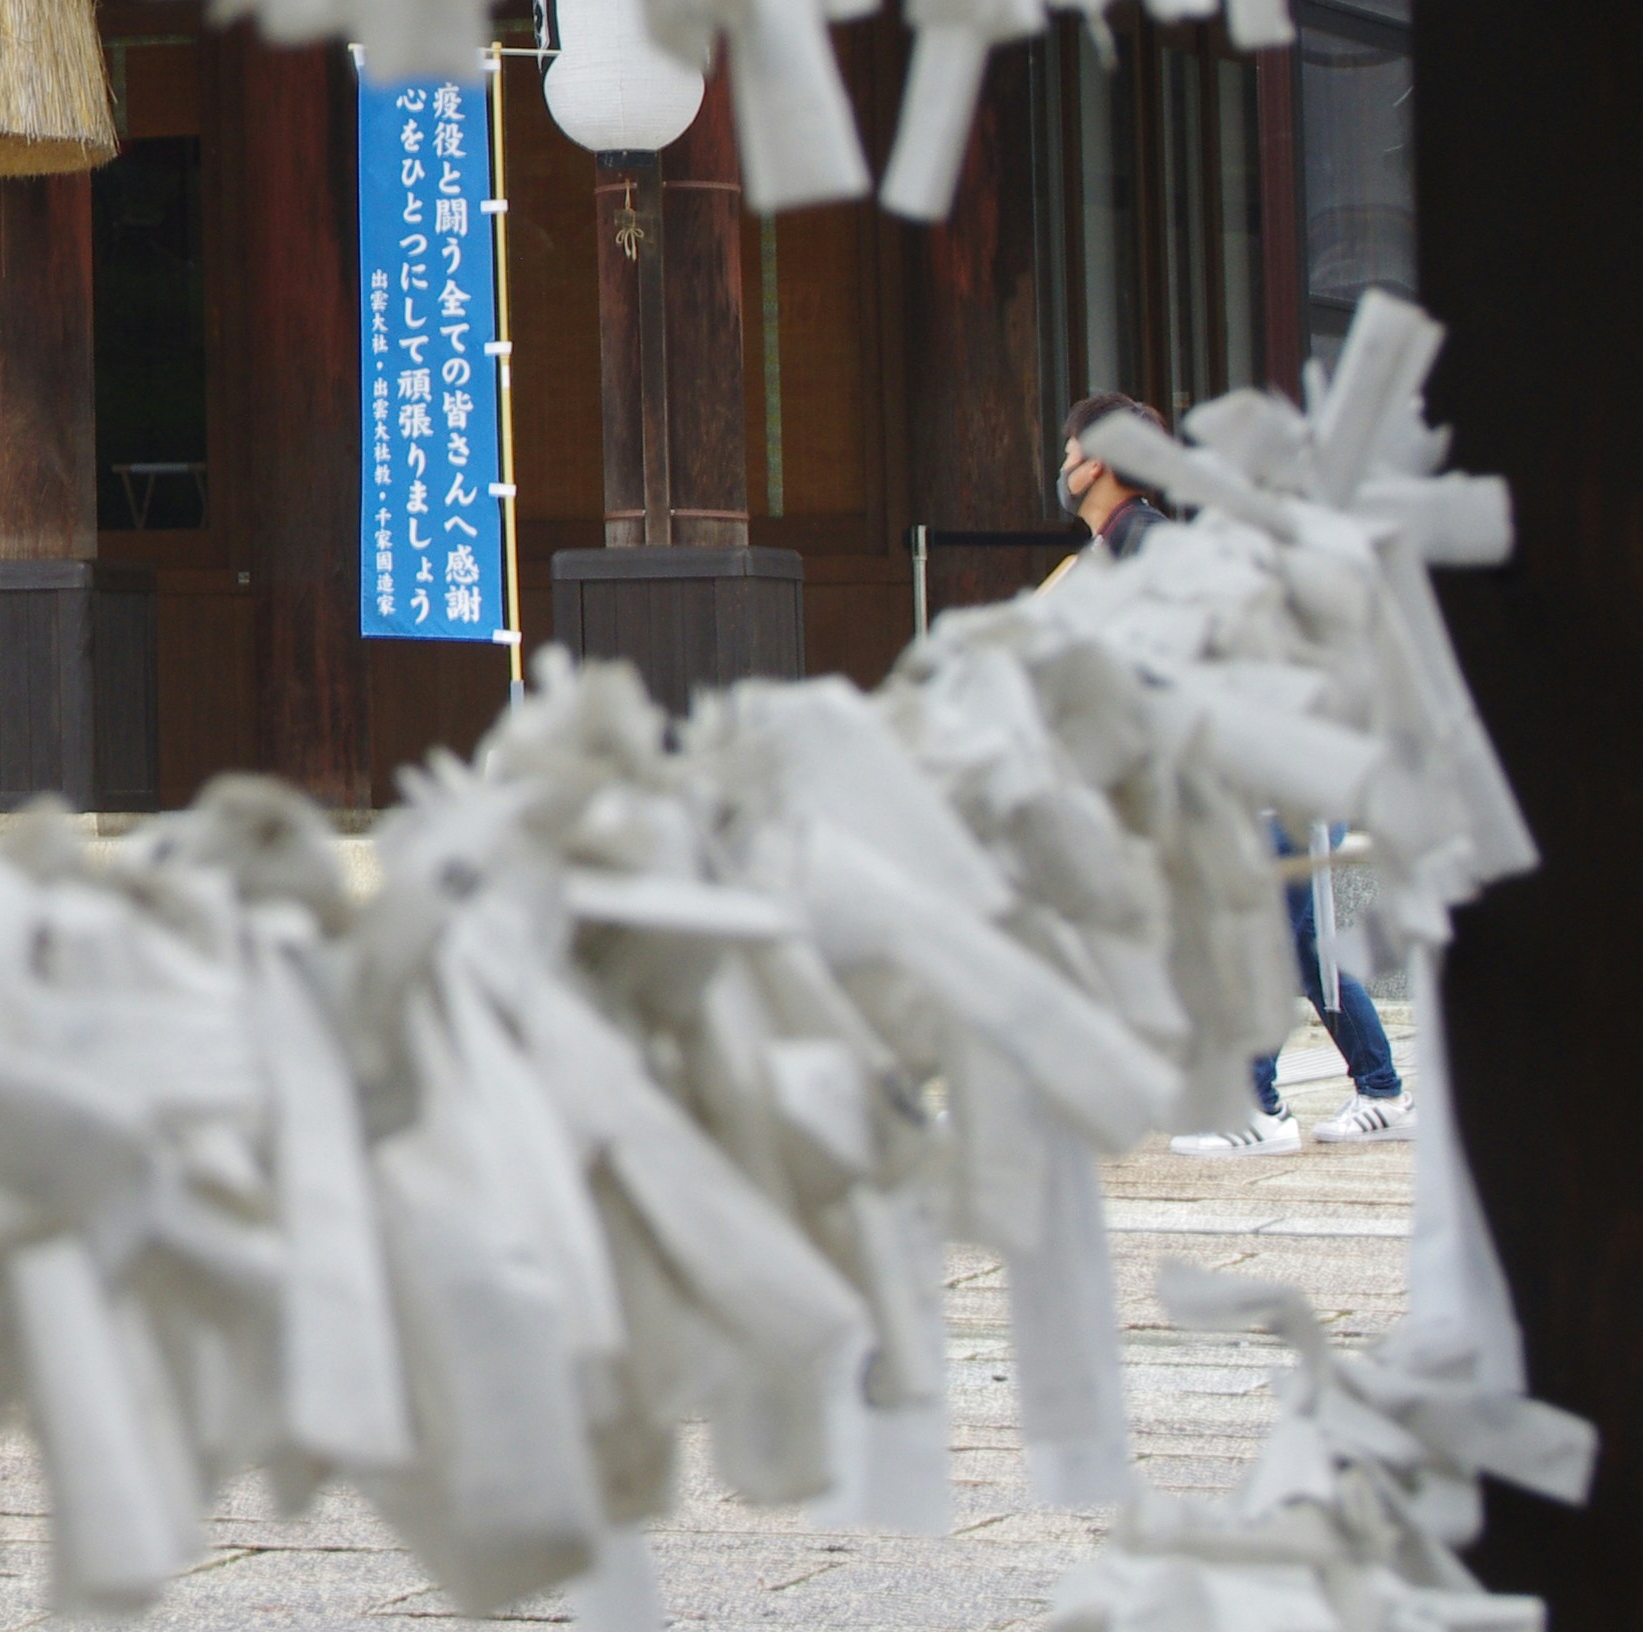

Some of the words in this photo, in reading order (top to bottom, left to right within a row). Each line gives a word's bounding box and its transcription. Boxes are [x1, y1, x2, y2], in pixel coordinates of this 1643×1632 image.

[396, 88, 434, 624] 心をひとつにして頑張りましょう
[432, 81, 482, 625] 疫役と闘う全ての皆さんへ感謝
